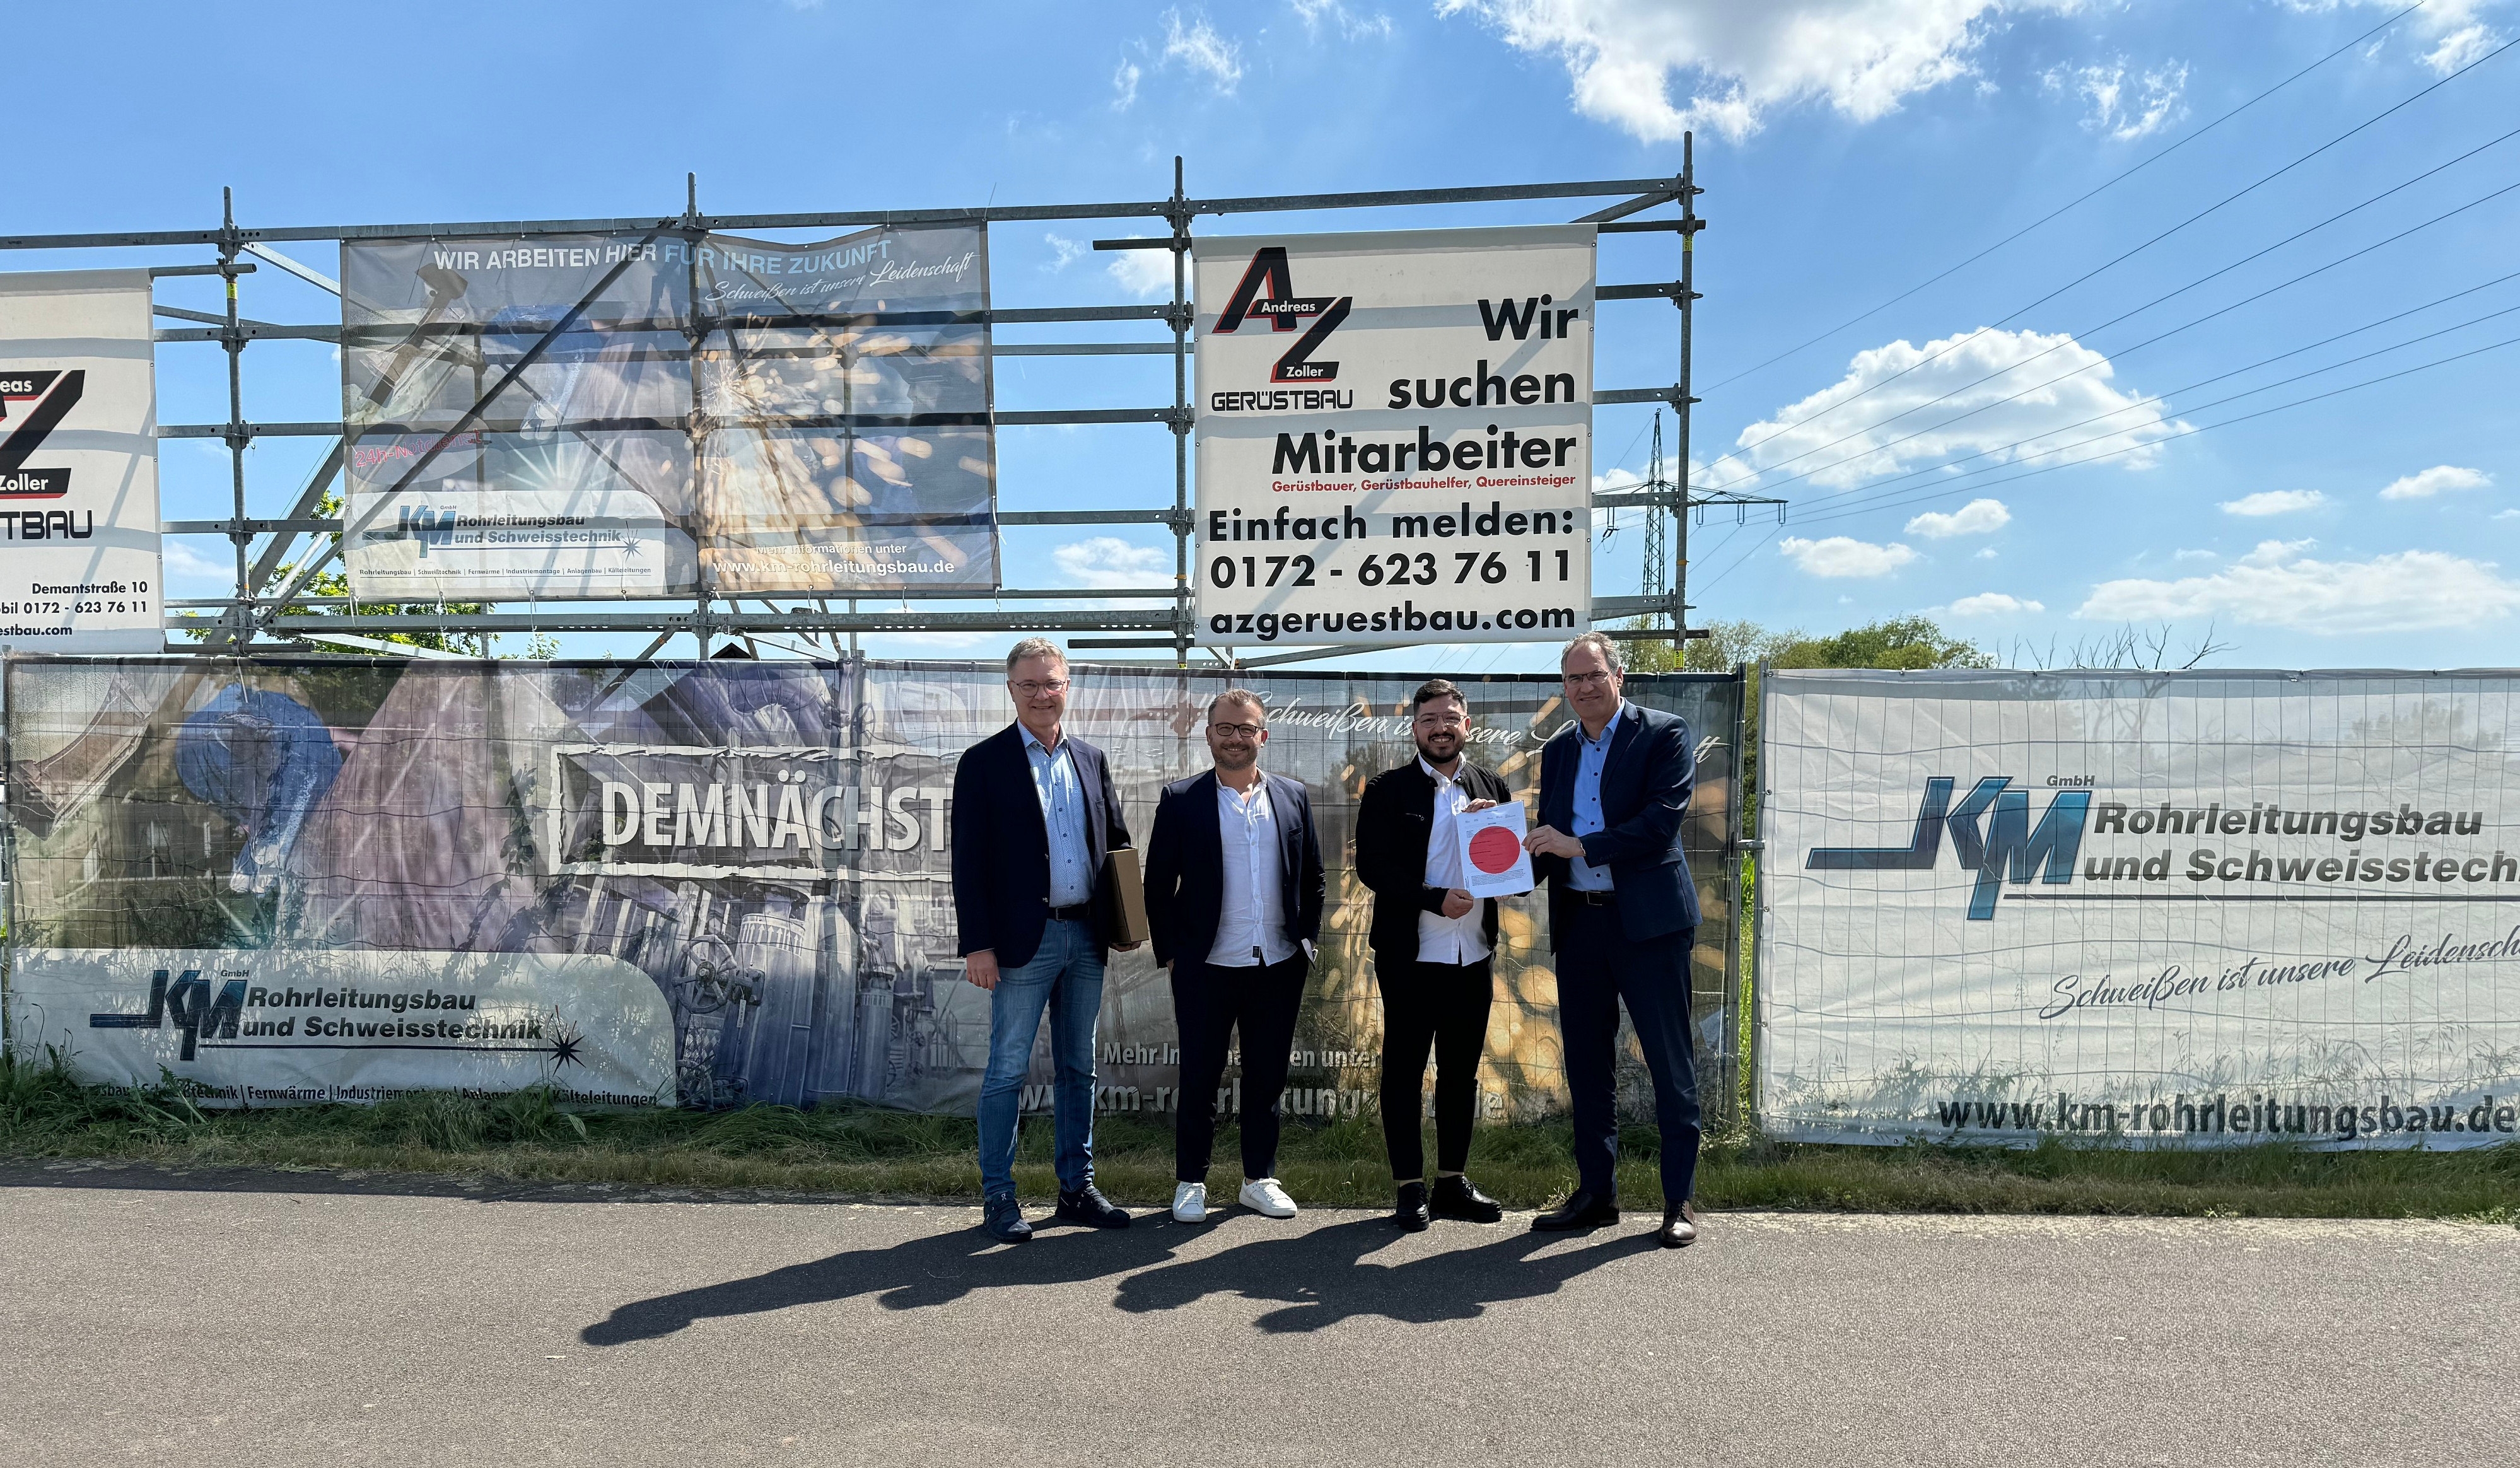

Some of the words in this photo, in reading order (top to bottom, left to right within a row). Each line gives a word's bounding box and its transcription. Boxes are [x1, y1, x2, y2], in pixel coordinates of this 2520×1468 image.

[434, 251, 479, 270] WIR
[486, 248, 600, 269] ARBEITEN
[605, 243, 657, 264] HIER
[665, 241, 715, 268] FÜR
[723, 252, 781, 274] IHRE
[788, 239, 892, 274] ZUKUNFT
[705, 281, 798, 302] Schweißen
[799, 279, 824, 295] ist
[820, 275, 867, 293] unsere
[870, 252, 980, 288] Leidenschaft
[1261, 300, 1316, 313] Andreas
[1478, 294, 1579, 341] Wir
[1286, 366, 1324, 378] Zoller
[1387, 359, 1575, 409] suchen
[0, 380, 32, 392] eas
[1211, 389, 1353, 412] GERÜSTBAU
[355, 428, 482, 467] 24h-Notdienst
[1272, 424, 1577, 475] Mitarbeiter
[1272, 479, 1357, 493] Gerüstbauer,
[1361, 476, 1473, 491] Gerüstbauhelfer,
[1476, 474, 1575, 489] Quereinsteiger
[0, 510, 93, 540] TBAU
[456, 513, 585, 528] Rohrleitungsbau
[1209, 505, 1367, 541] Einfach
[1392, 501, 1575, 539] melden:
[455, 531, 484, 544] und
[488, 529, 623, 544] Schweisstechnik
[756, 544, 786, 555] Mehr
[790, 543, 872, 554] Informationen
[875, 544, 907, 554] unter
[713, 559, 955, 576] www.km-rohrleitungsbau.de
[1210, 554, 1316, 589] 0172
[1357, 552, 1437, 587] 623
[1454, 550, 1507, 585] 76
[1527, 550, 1569, 581] 11
[32, 581, 126, 594] Demantstraße
[132, 581, 148, 593] 10
[0, 602, 18, 614] bil
[23, 602, 60, 614] 0172
[74, 601, 102, 614] 623
[107, 601, 125, 613] 76
[132, 601, 147, 612] 11
[1210, 600, 1575, 641] azgeruestbau.com
[2046, 774, 2096, 787] GmbH
[602, 769, 954, 851] DEMNÄCHST
[2094, 801, 2483, 842] Rohrleitungsbau
[2084, 849, 2172, 882] und
[2185, 848, 2520, 883] Schweisstech
[247, 987, 476, 1013] Rohrleitungsbau
[2039, 965, 2210, 1019] Schweißen
[2217, 957, 2259, 993] ist
[2258, 956, 2356, 986] unsere
[242, 1017, 295, 1037] und
[304, 1015, 543, 1040] Schweisstechnik
[1103, 1041, 1158, 1065] Mehr
[1321, 1047, 1382, 1068] unter
[247, 1085, 325, 1100] Fernwärme
[1937, 1092, 2517, 1141] www.km-rohrleitungsbau.de
